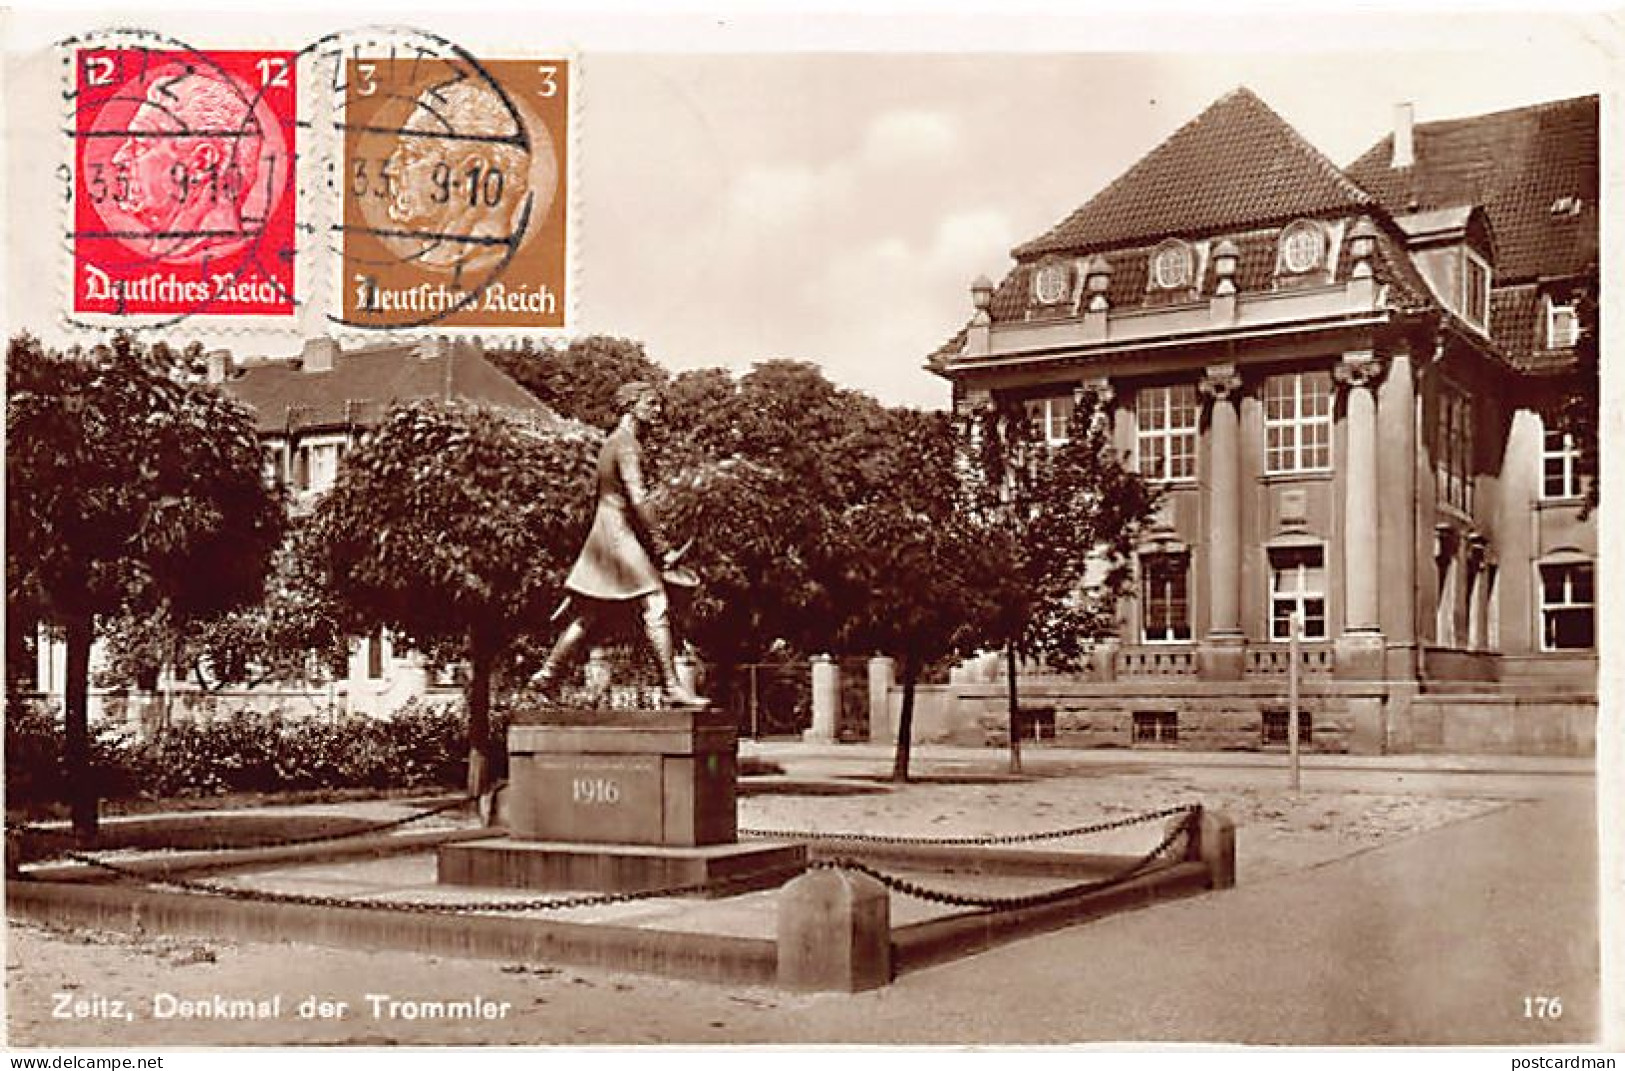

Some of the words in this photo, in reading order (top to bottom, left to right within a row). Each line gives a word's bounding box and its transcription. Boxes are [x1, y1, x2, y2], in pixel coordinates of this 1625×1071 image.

[86, 57, 114, 85] 12
[255, 57, 289, 87] 12
[356, 64, 376, 96] 3
[537, 66, 558, 97] 3
[482, 282, 556, 313] Reich
[572, 777, 620, 805] 1916
